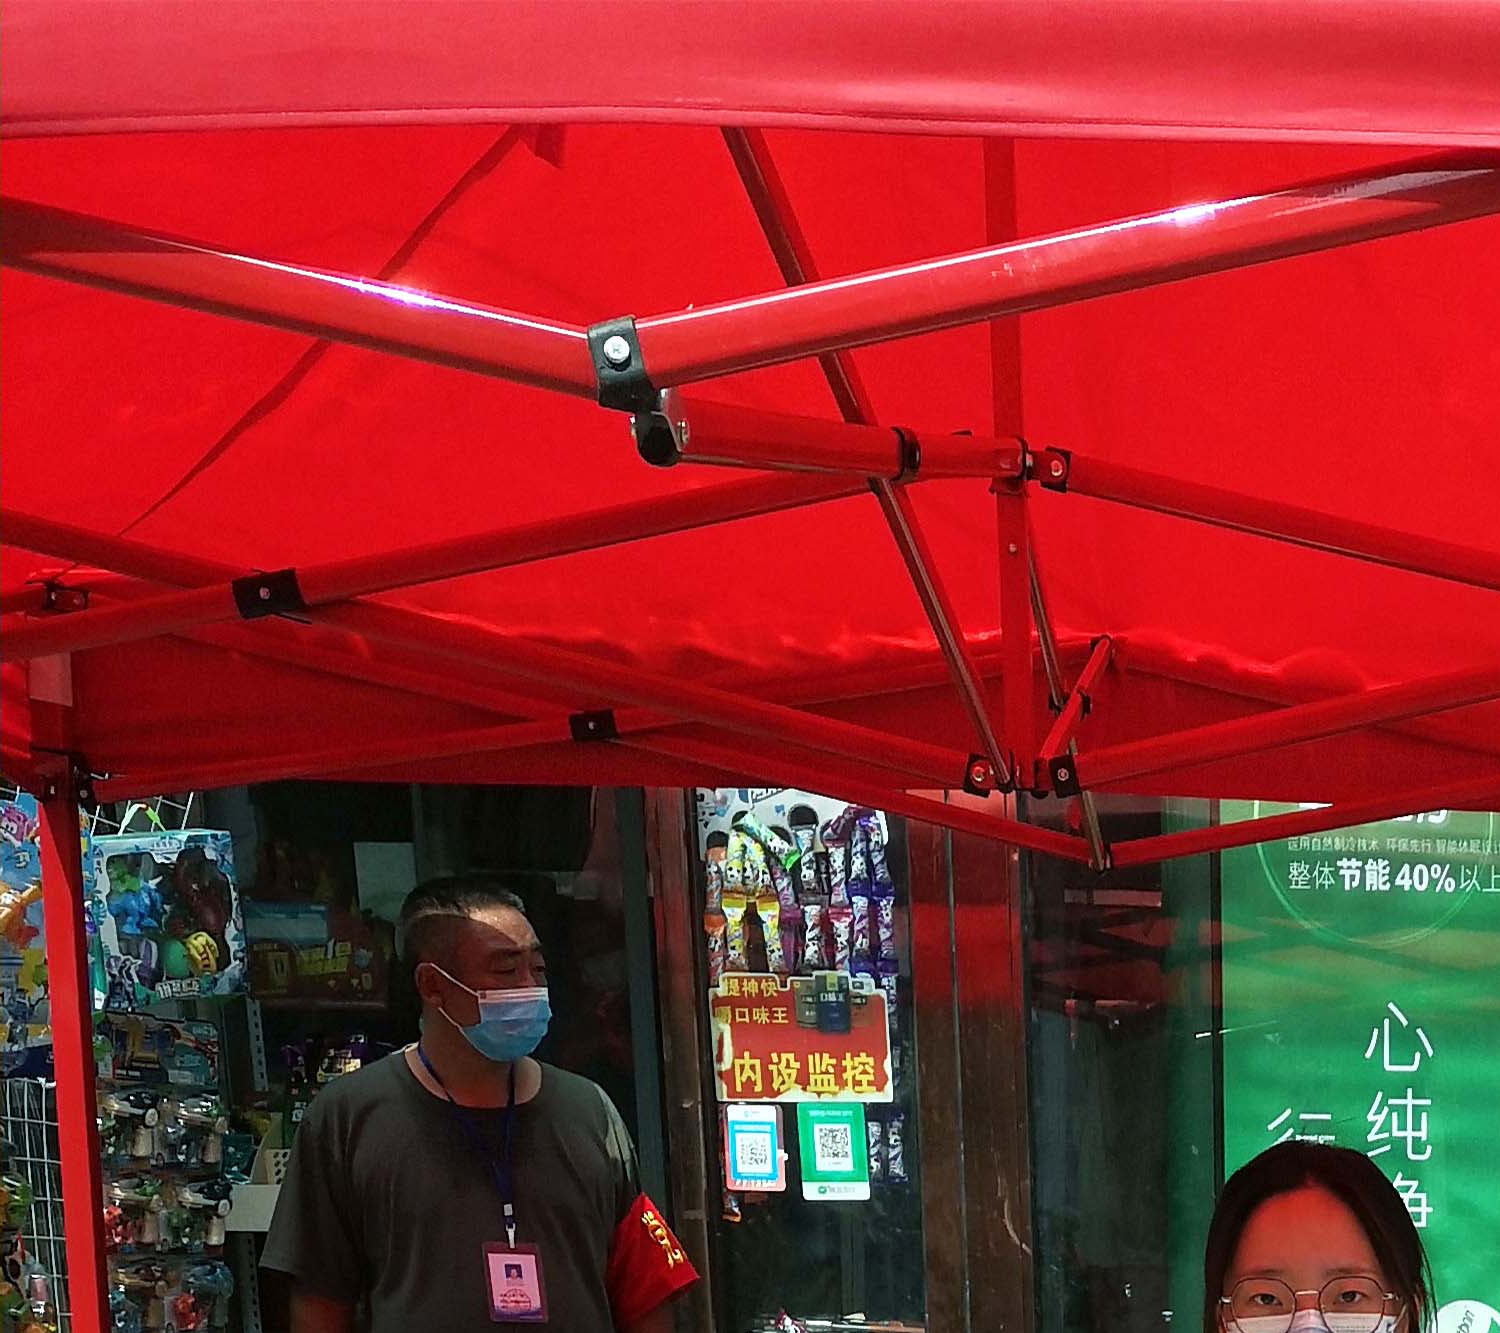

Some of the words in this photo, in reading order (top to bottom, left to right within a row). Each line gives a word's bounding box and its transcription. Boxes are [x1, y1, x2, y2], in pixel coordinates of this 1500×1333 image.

[715, 1006, 790, 1025] 口味王
[733, 1050, 878, 1095] 内设监控
